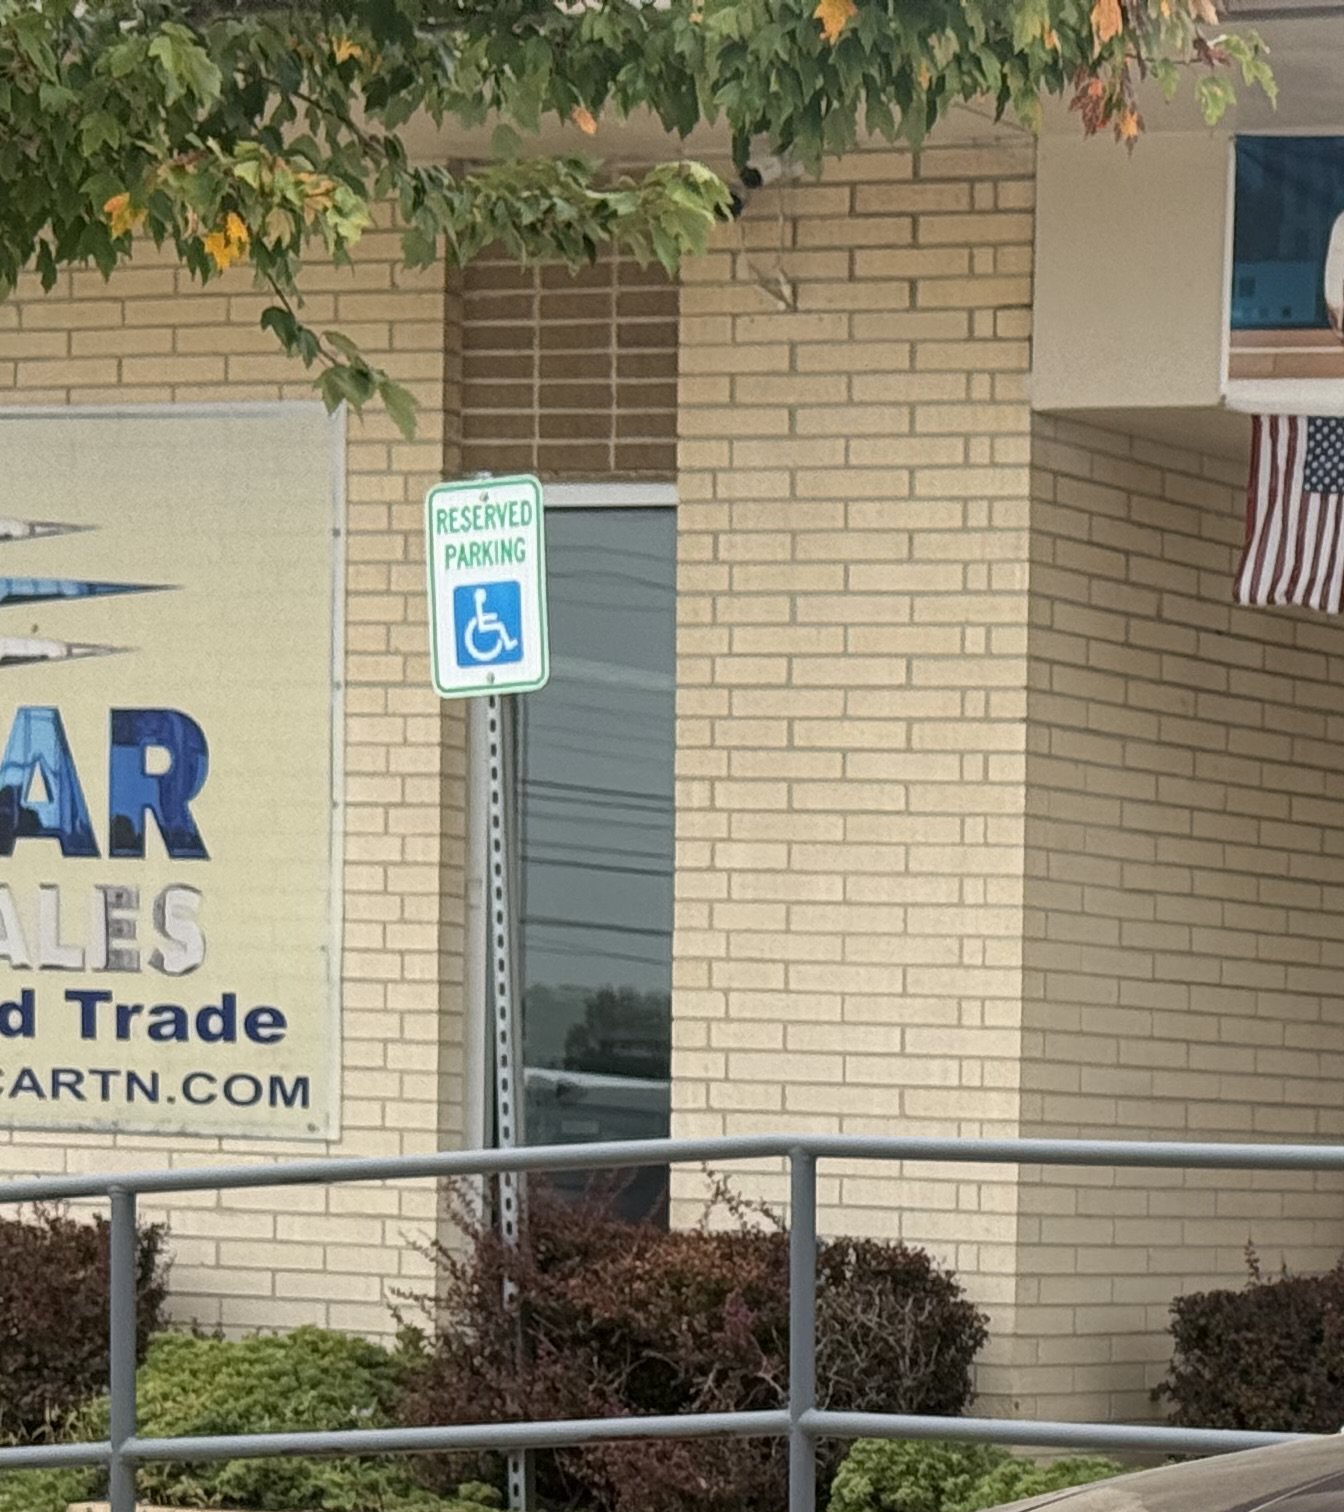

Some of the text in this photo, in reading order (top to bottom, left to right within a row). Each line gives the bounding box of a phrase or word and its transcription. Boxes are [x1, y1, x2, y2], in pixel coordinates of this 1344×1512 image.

[436, 499, 533, 535] RESERVED
[444, 536, 527, 570] PARKING
[65, 988, 287, 1044] Trade
[0, 1066, 310, 1110] ARTN.COM
